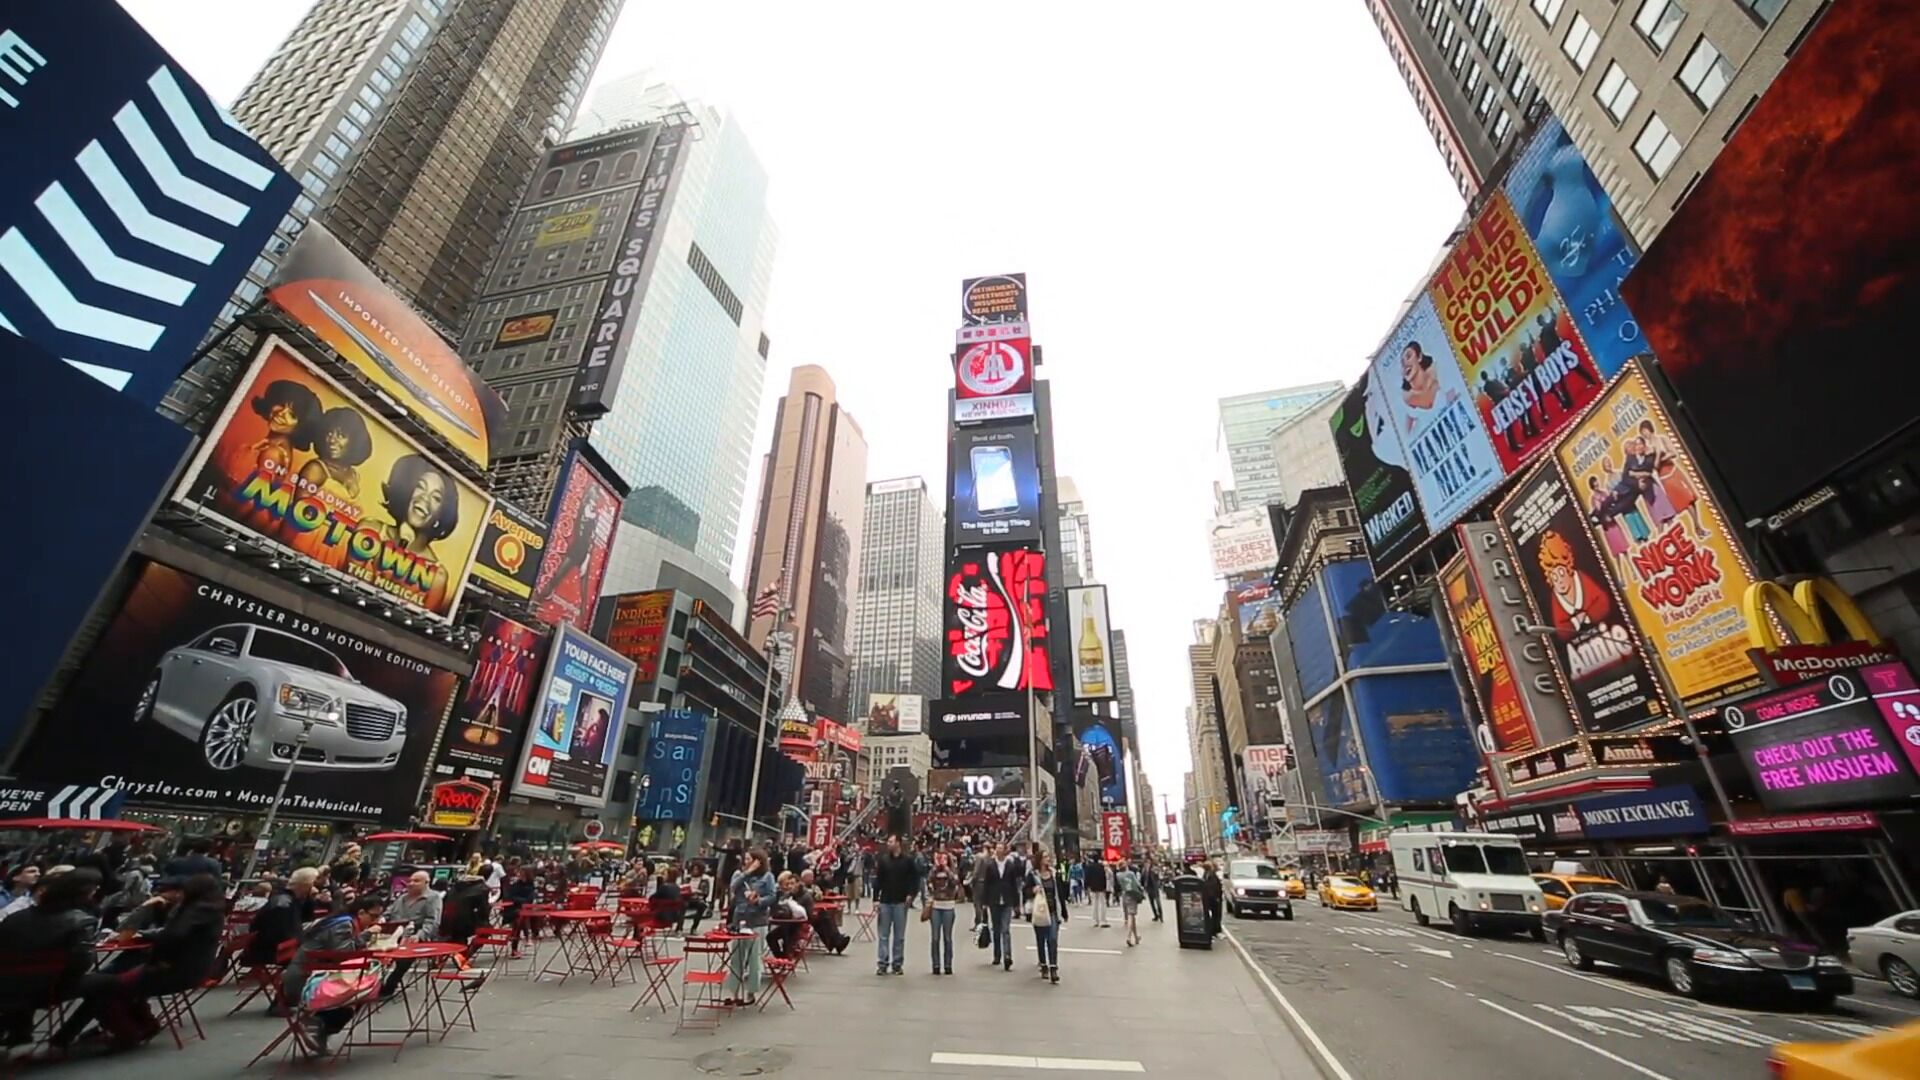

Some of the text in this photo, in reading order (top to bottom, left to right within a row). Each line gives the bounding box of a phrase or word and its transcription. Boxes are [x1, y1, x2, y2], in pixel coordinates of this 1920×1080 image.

[588, 143, 677, 368] TIMES SQUARE
[1435, 202, 1509, 300] THE
[1446, 229, 1516, 321] CROWD
[1454, 248, 1528, 342] GOES
[338, 291, 400, 347] IMPORTED
[402, 346, 429, 374] FROM
[1461, 268, 1543, 365] WILD!
[579, 383, 599, 392] NYC
[972, 400, 1017, 410] XINHUA
[1490, 339, 1580, 435] JERSEY BOYS
[1411, 401, 1476, 473] MAMMA
[262, 458, 363, 518] ON BROADWAY
[240, 470, 440, 593] MOTOWN
[489, 509, 544, 549] Avenue
[1214, 540, 1272, 558] THE BEST
[494, 533, 525, 575] Q
[1632, 521, 1695, 578] NICE
[347, 563, 426, 607] THE MUSICAL
[1641, 550, 1720, 610] WORK
[197, 584, 432, 676] CHRYSLER 300 MOTOWN EDITION
[616, 607, 663, 620] INDICES
[1481, 532, 1555, 693] PALACE
[564, 641, 589, 665] YOUR
[587, 654, 609, 674] FACE
[1566, 622, 1633, 681] Annie
[1773, 652, 1894, 672] McDonald's
[957, 712, 992, 721] HYUNDAI
[1756, 694, 1820, 721] COME INSIDE
[1603, 740, 1654, 762] Annie
[1754, 728, 1879, 767] CHECK OUT THE
[100, 775, 218, 799] Chrysler.com
[963, 775, 994, 796] TO
[1759, 751, 1899, 790] FREE MUSUEM
[0, 789, 45, 801] WE'RE
[1582, 800, 1694, 827] MONEY EXCHANGE
[813, 817, 826, 845] tkts
[1108, 815, 1125, 847] tkts
